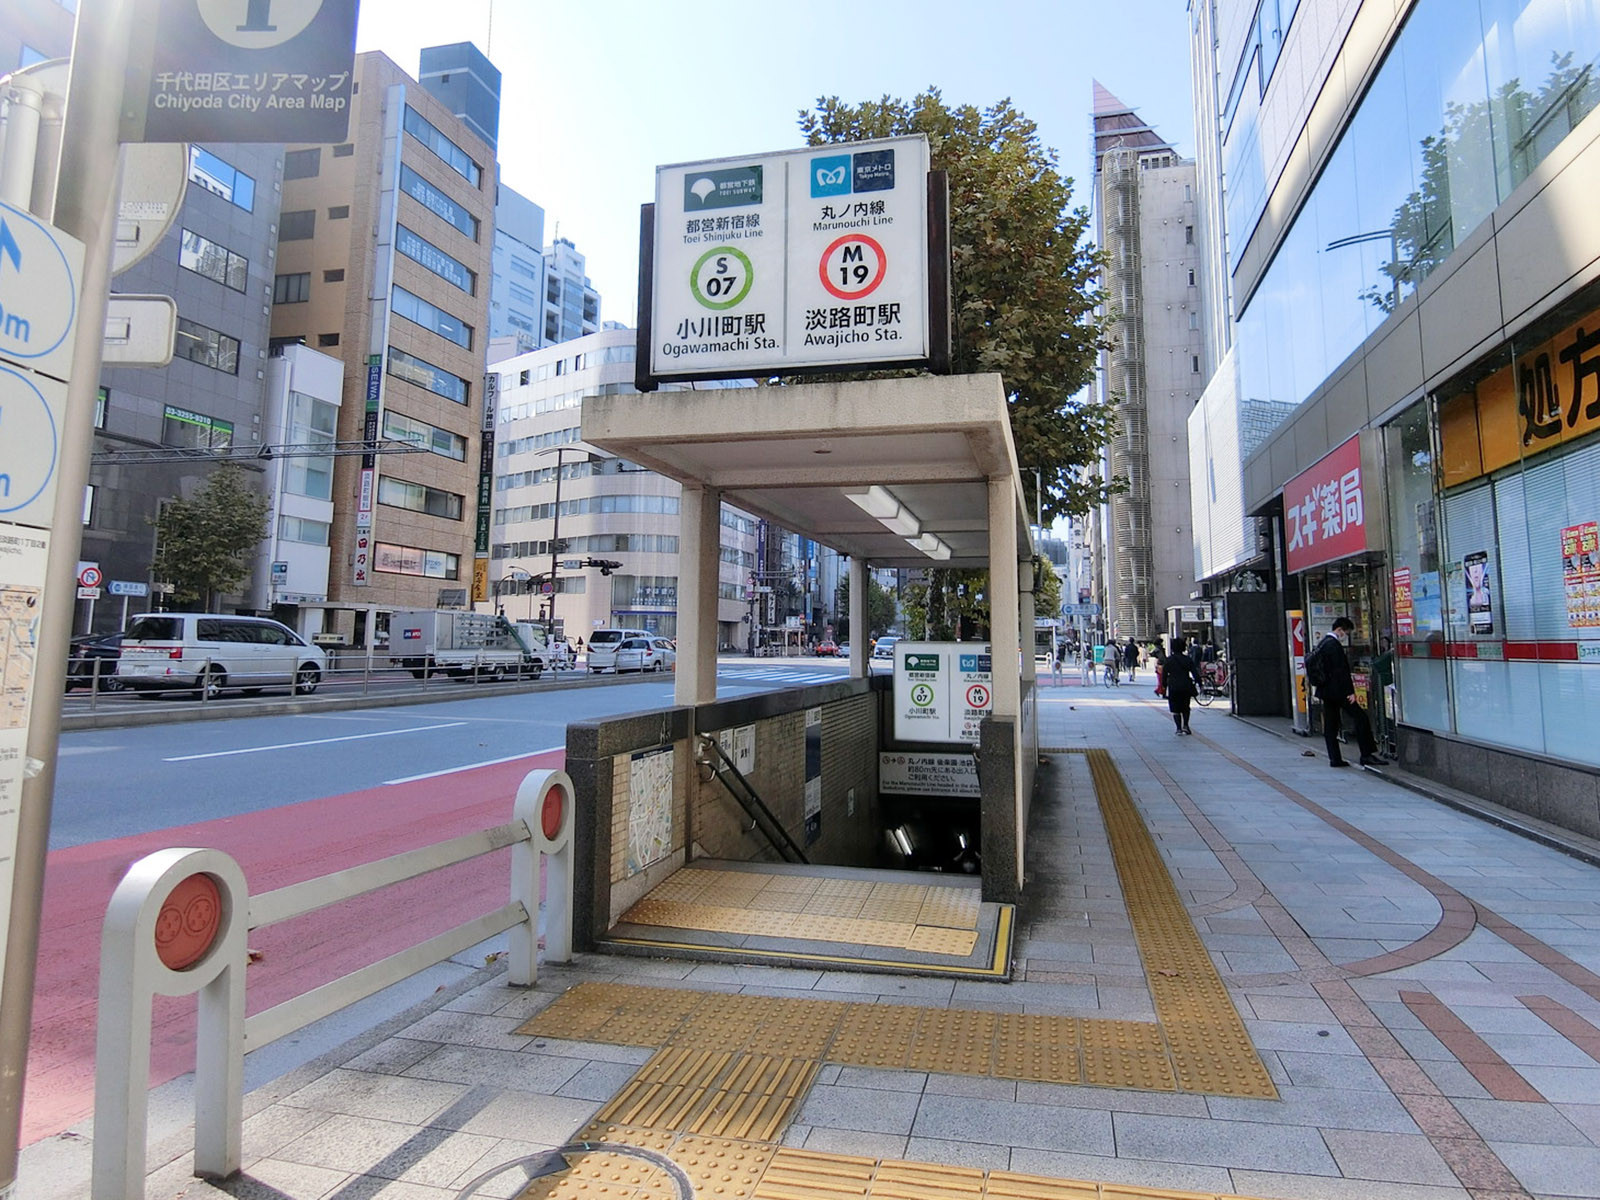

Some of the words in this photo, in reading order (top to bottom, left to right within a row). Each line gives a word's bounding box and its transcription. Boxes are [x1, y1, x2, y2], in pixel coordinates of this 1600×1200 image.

[156, 72, 349, 93] 千代田区エリアマップ
[155, 94, 222, 112] Chiyoda
[228, 95, 261, 112] City
[265, 95, 305, 109] Area
[310, 95, 346, 112] Map
[857, 163, 892, 173] 東京メトロ
[821, 200, 886, 220] 丸ノ内線
[686, 213, 761, 234] 都営新宿線
[813, 217, 870, 231] Marunouchi
[873, 215, 894, 225] Line
[683, 233, 701, 244] Toei
[703, 230, 742, 243] Shinjuku
[744, 228, 764, 238] Line
[842, 245, 863, 263] M
[716, 257, 728, 274] S
[840, 265, 869, 285] 19
[706, 277, 737, 296] 07
[805, 302, 901, 330] 淡路町駅
[676, 313, 765, 339] 小川町駅
[663, 337, 749, 358] Ogawamachi
[754, 337, 780, 349] Sta.
[804, 329, 870, 348] Awajicho
[875, 328, 903, 341] Sta.
[1288, 467, 1363, 552] スギ薬局
[916, 694, 928, 702] 07
[907, 757, 934, 765] 丸ノ内線
